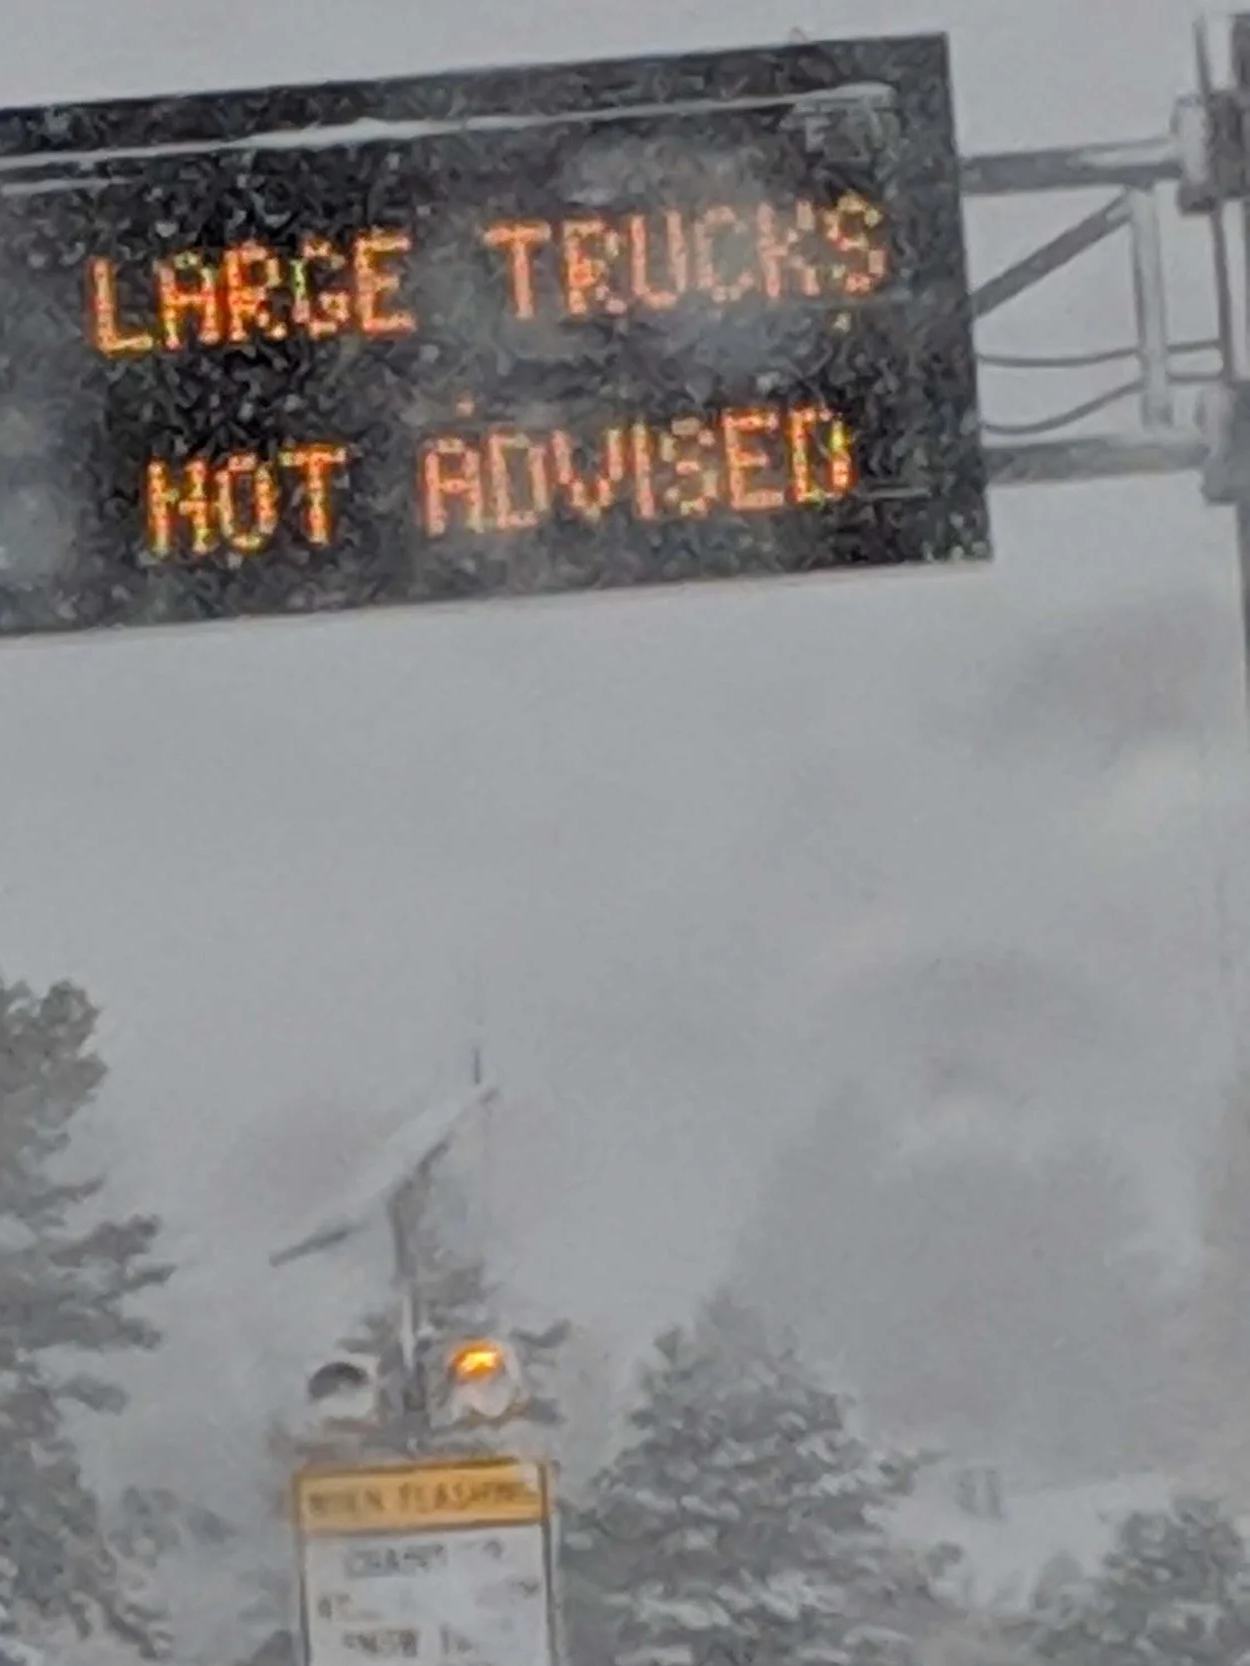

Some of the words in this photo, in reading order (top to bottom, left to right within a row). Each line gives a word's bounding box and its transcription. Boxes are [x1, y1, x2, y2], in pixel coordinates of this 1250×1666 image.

[90, 230, 416, 356] LARGE
[481, 191, 889, 320] TRUCKS
[145, 443, 352, 557] NOT
[420, 405, 854, 538] ADVISED
